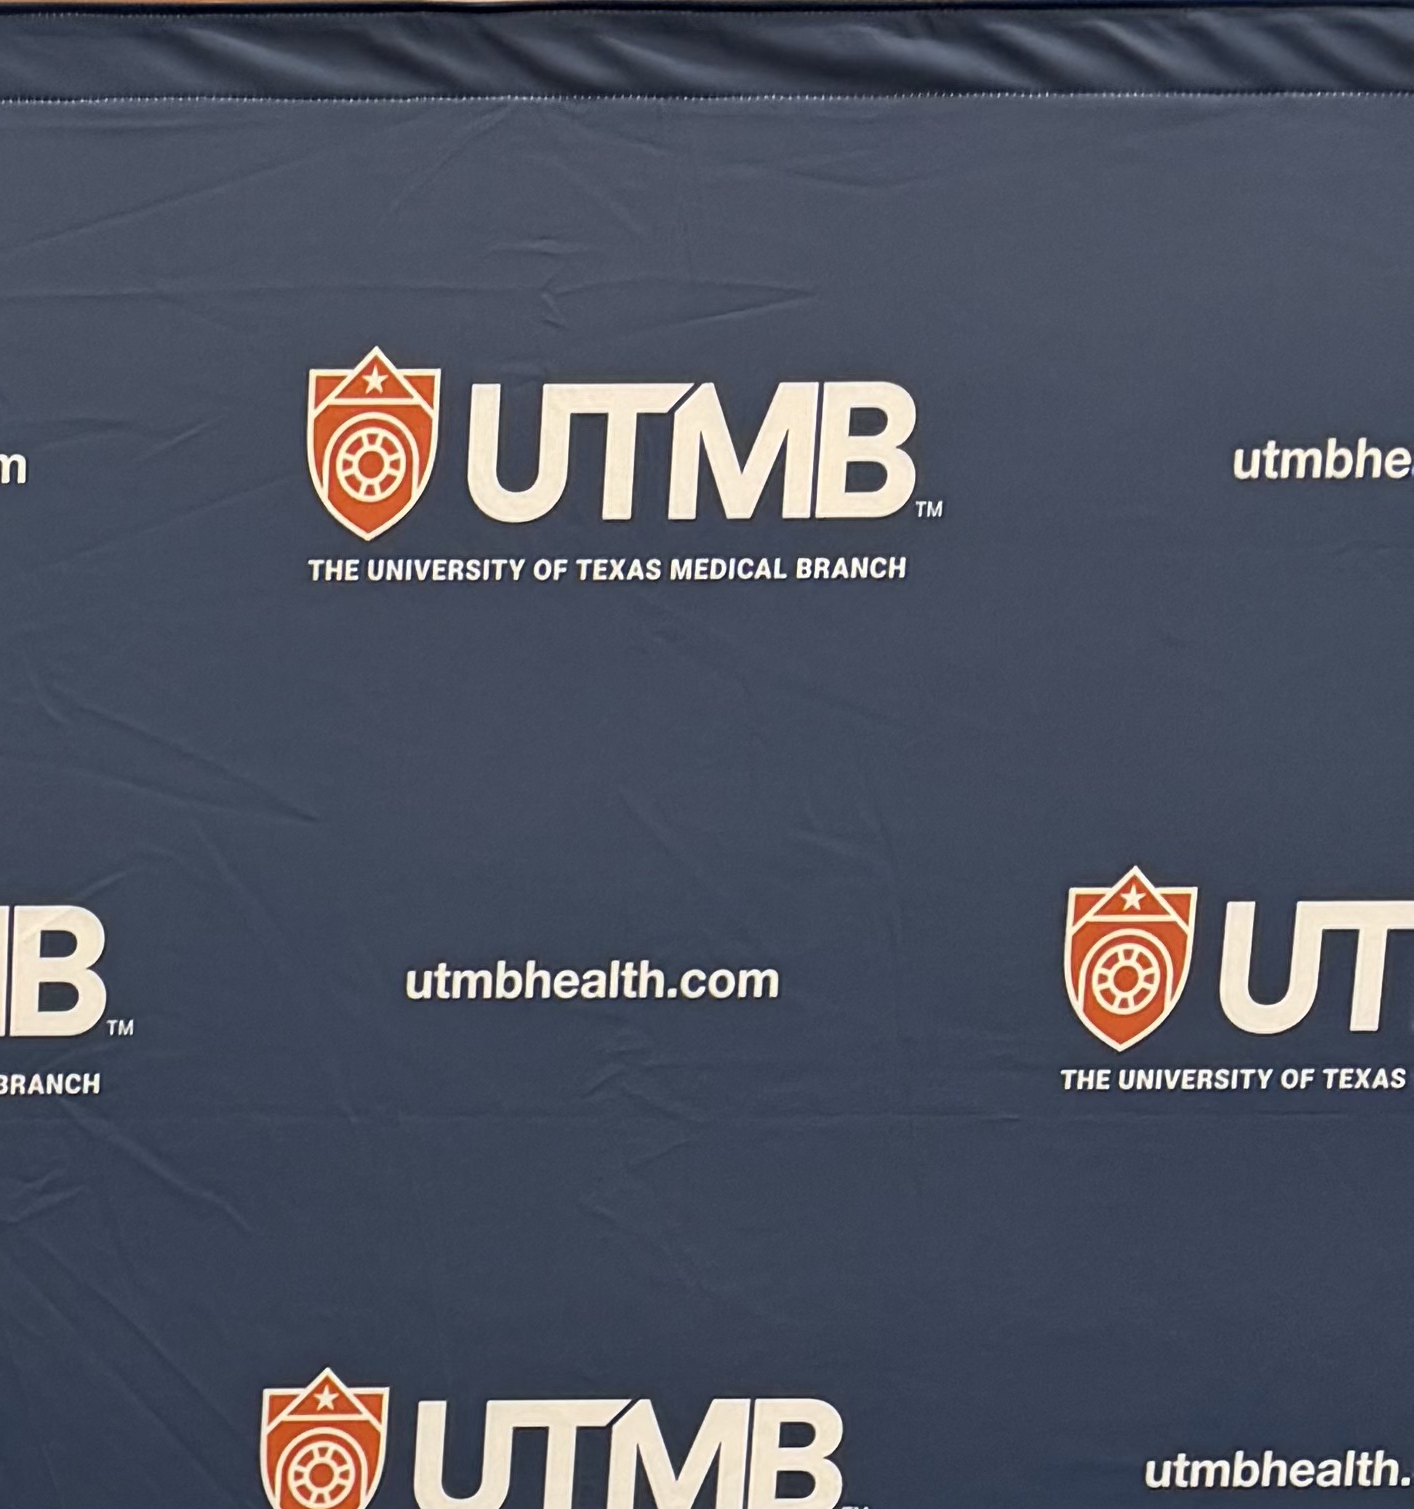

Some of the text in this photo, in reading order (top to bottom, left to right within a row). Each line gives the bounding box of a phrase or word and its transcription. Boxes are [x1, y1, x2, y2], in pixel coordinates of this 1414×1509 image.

[468, 381, 916, 522] UTMB
[405, 959, 779, 1000] utmbhealth.com
[1220, 900, 1414, 1034] UT
[1145, 1449, 1412, 1489] utmbhealth.
